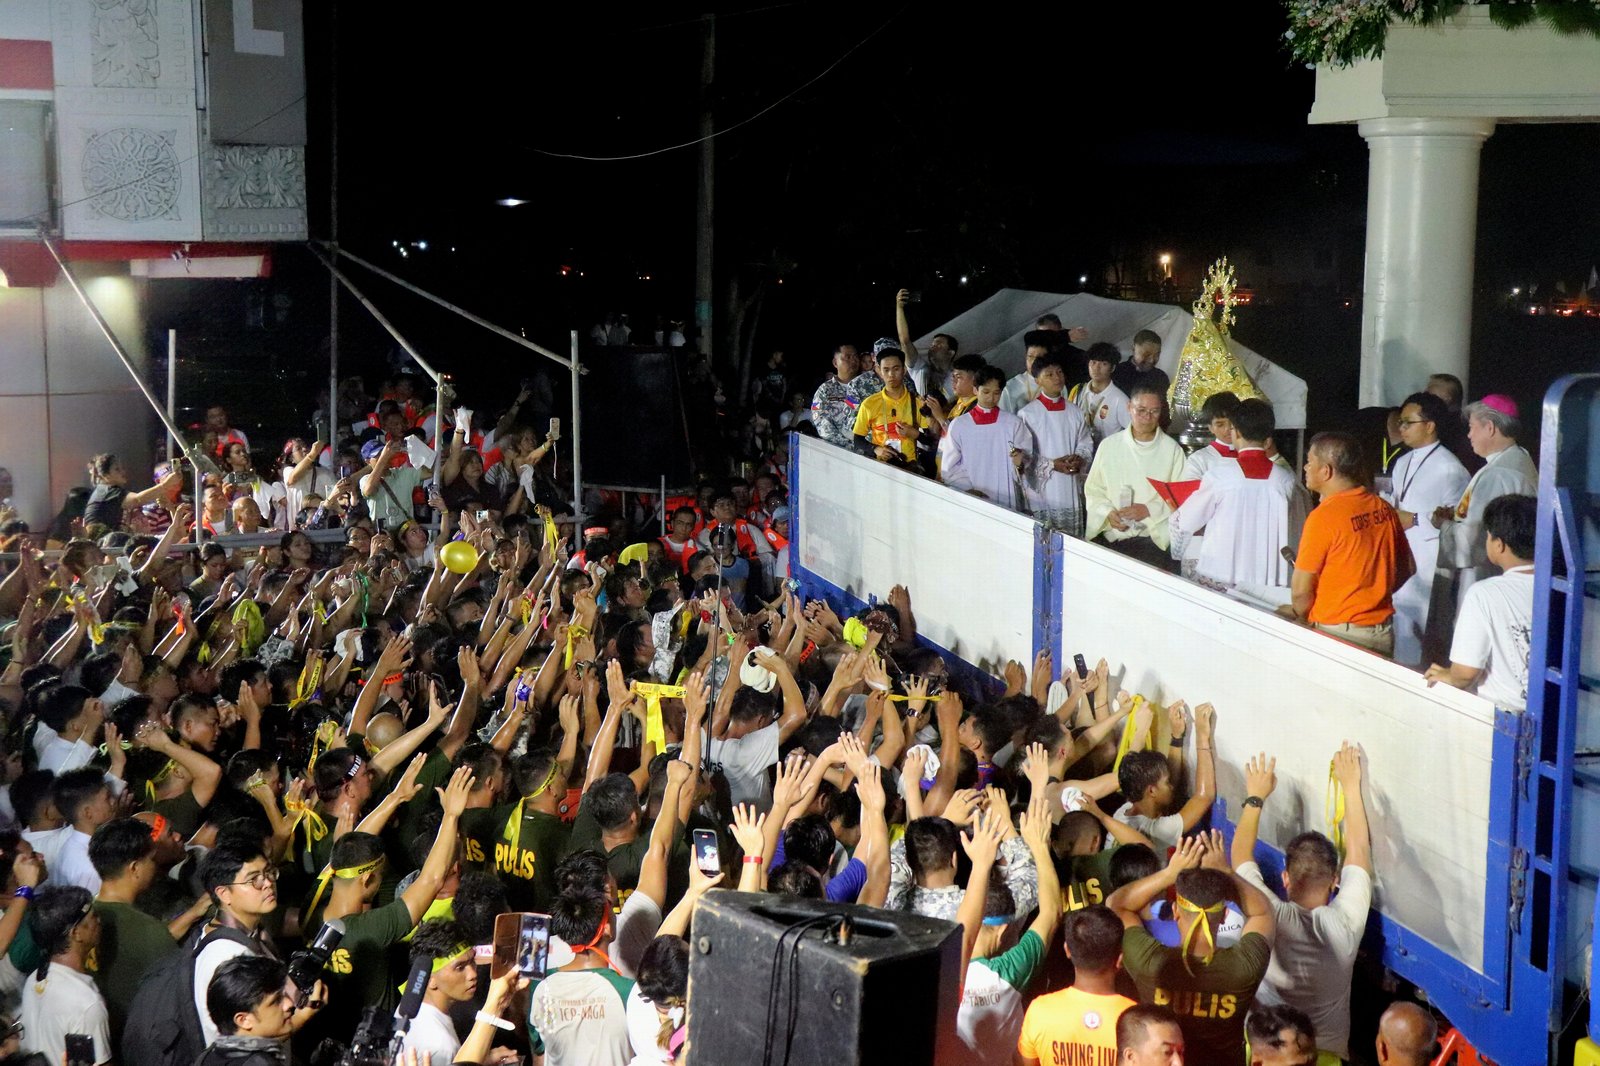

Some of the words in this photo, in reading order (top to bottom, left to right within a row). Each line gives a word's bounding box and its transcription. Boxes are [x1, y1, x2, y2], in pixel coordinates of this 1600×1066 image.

[495, 842, 536, 880] PULIS
[1218, 923, 1243, 933] ILICA
[1052, 1040, 1095, 1066] SAVING
[1097, 1045, 1118, 1066] LIV
